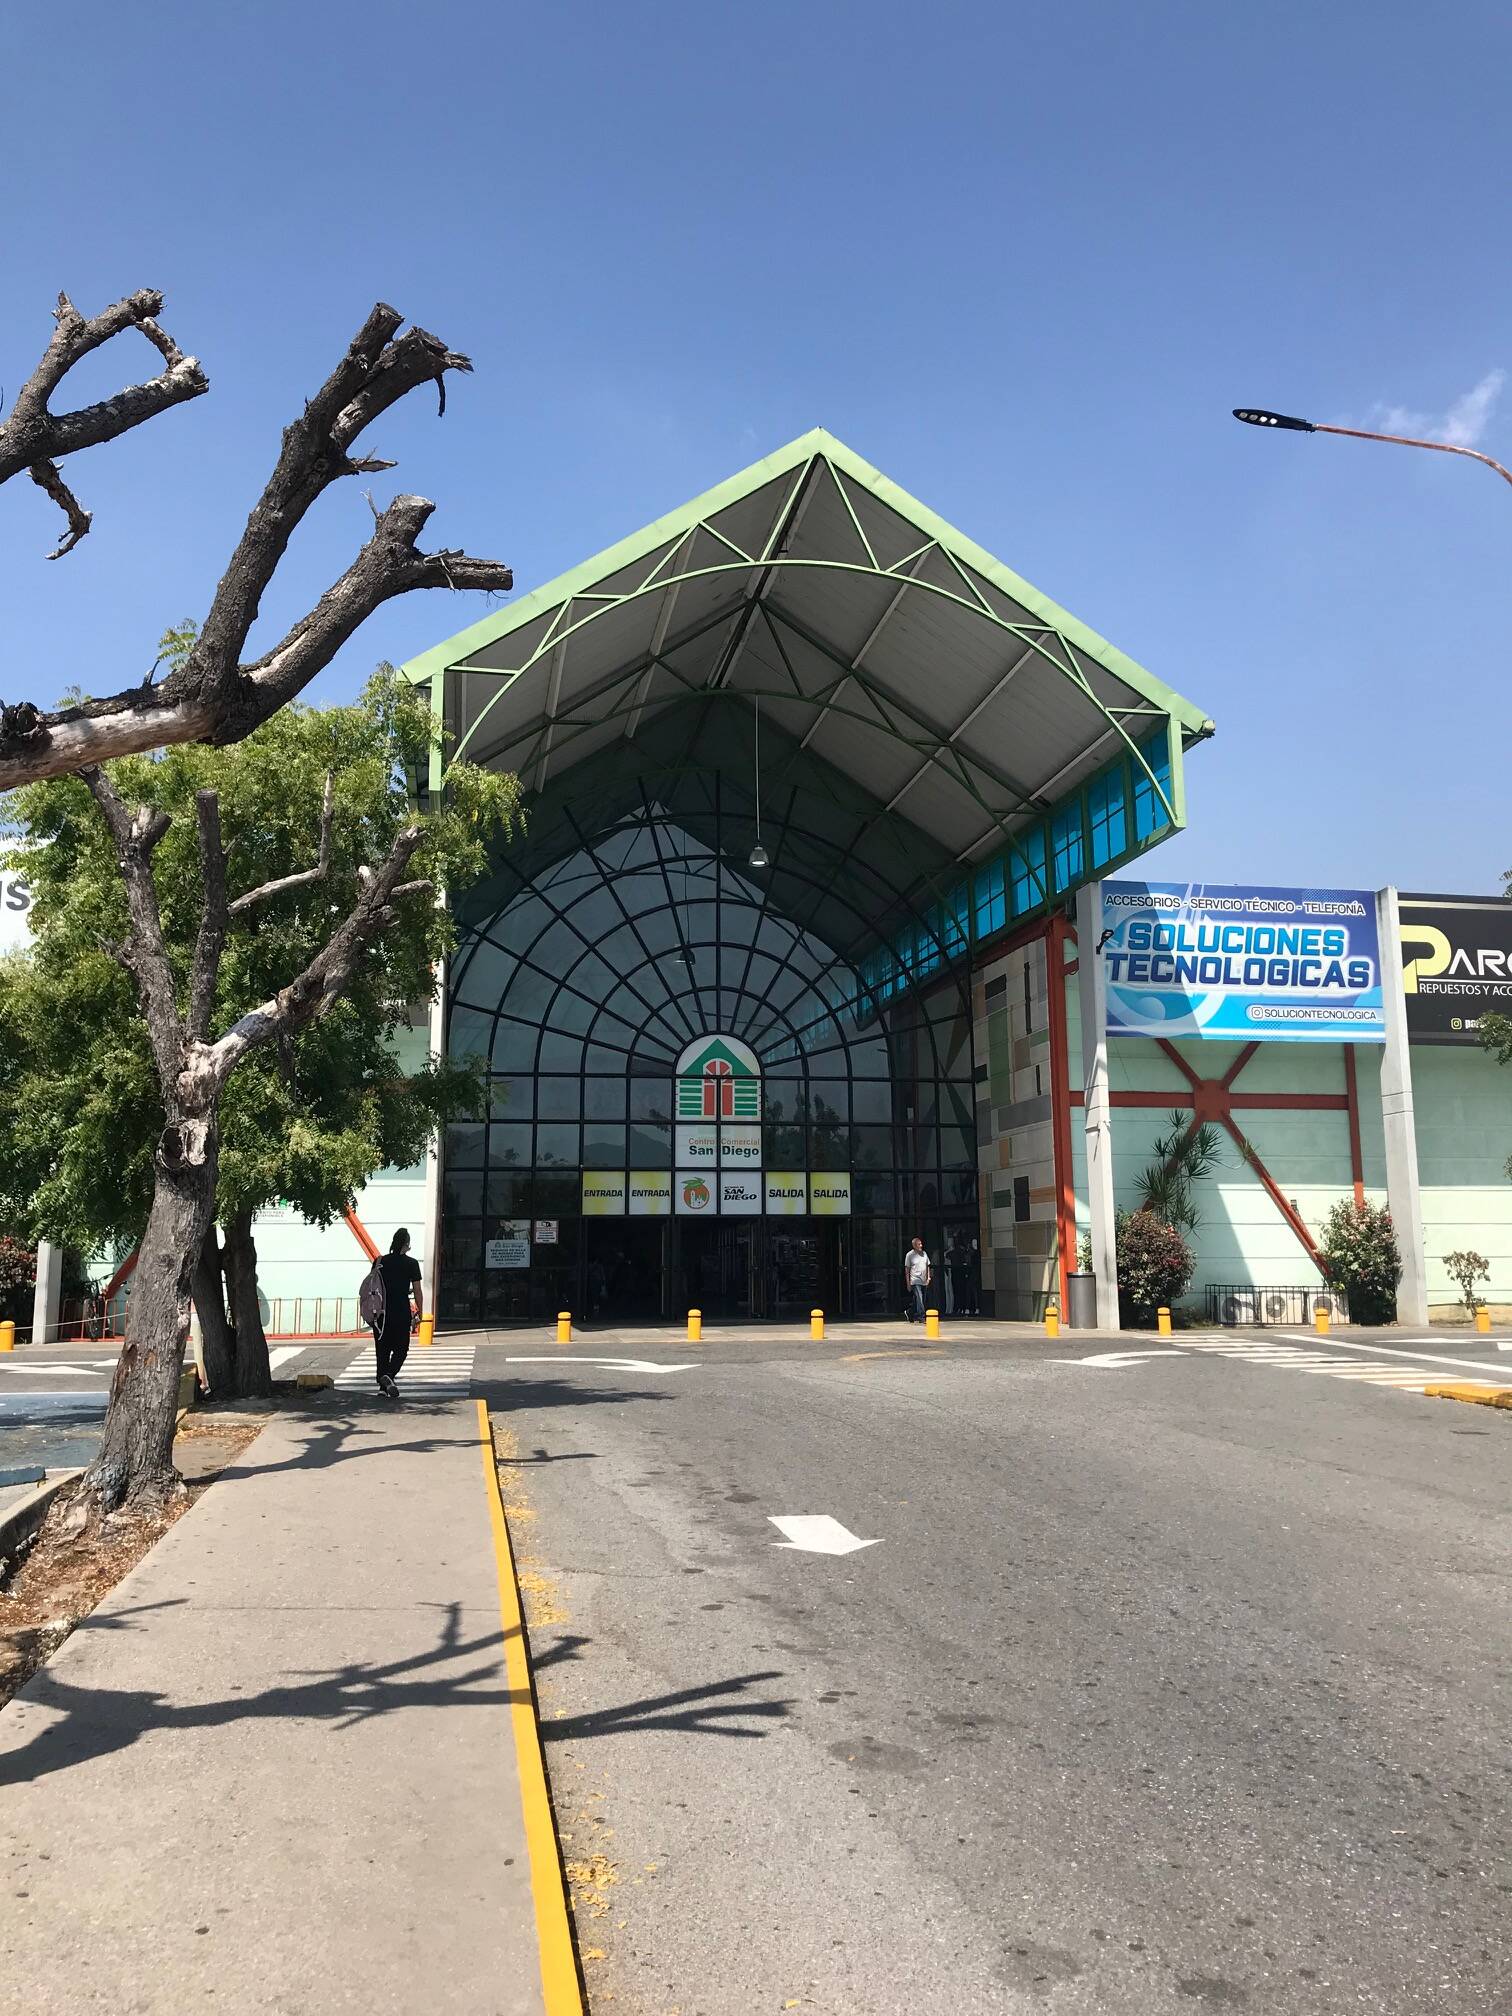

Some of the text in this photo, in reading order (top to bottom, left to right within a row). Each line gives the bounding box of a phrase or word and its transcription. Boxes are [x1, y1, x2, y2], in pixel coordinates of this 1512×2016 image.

[0, 880, 30, 911] S
[1105, 896, 1180, 908] ACCESORIOS
[1190, 899, 1243, 910] SERVICIO
[1246, 897, 1295, 912] TÉCNICO
[1304, 900, 1365, 915] TELEFONÍA
[1128, 922, 1345, 957] SOLUCIONES
[1106, 953, 1370, 988] TECNOLOGICAS
[1419, 983, 1481, 995] REPUESTOS
[1482, 985, 1490, 995] Y
[721, 1138, 760, 1146] Comercial
[689, 1145, 760, 1158] San Diego
[583, 1189, 623, 1198] ENTRADA
[631, 1189, 671, 1198] ENTRADA
[769, 1189, 804, 1198] SALIDA
[813, 1189, 849, 1198] SALIDA
